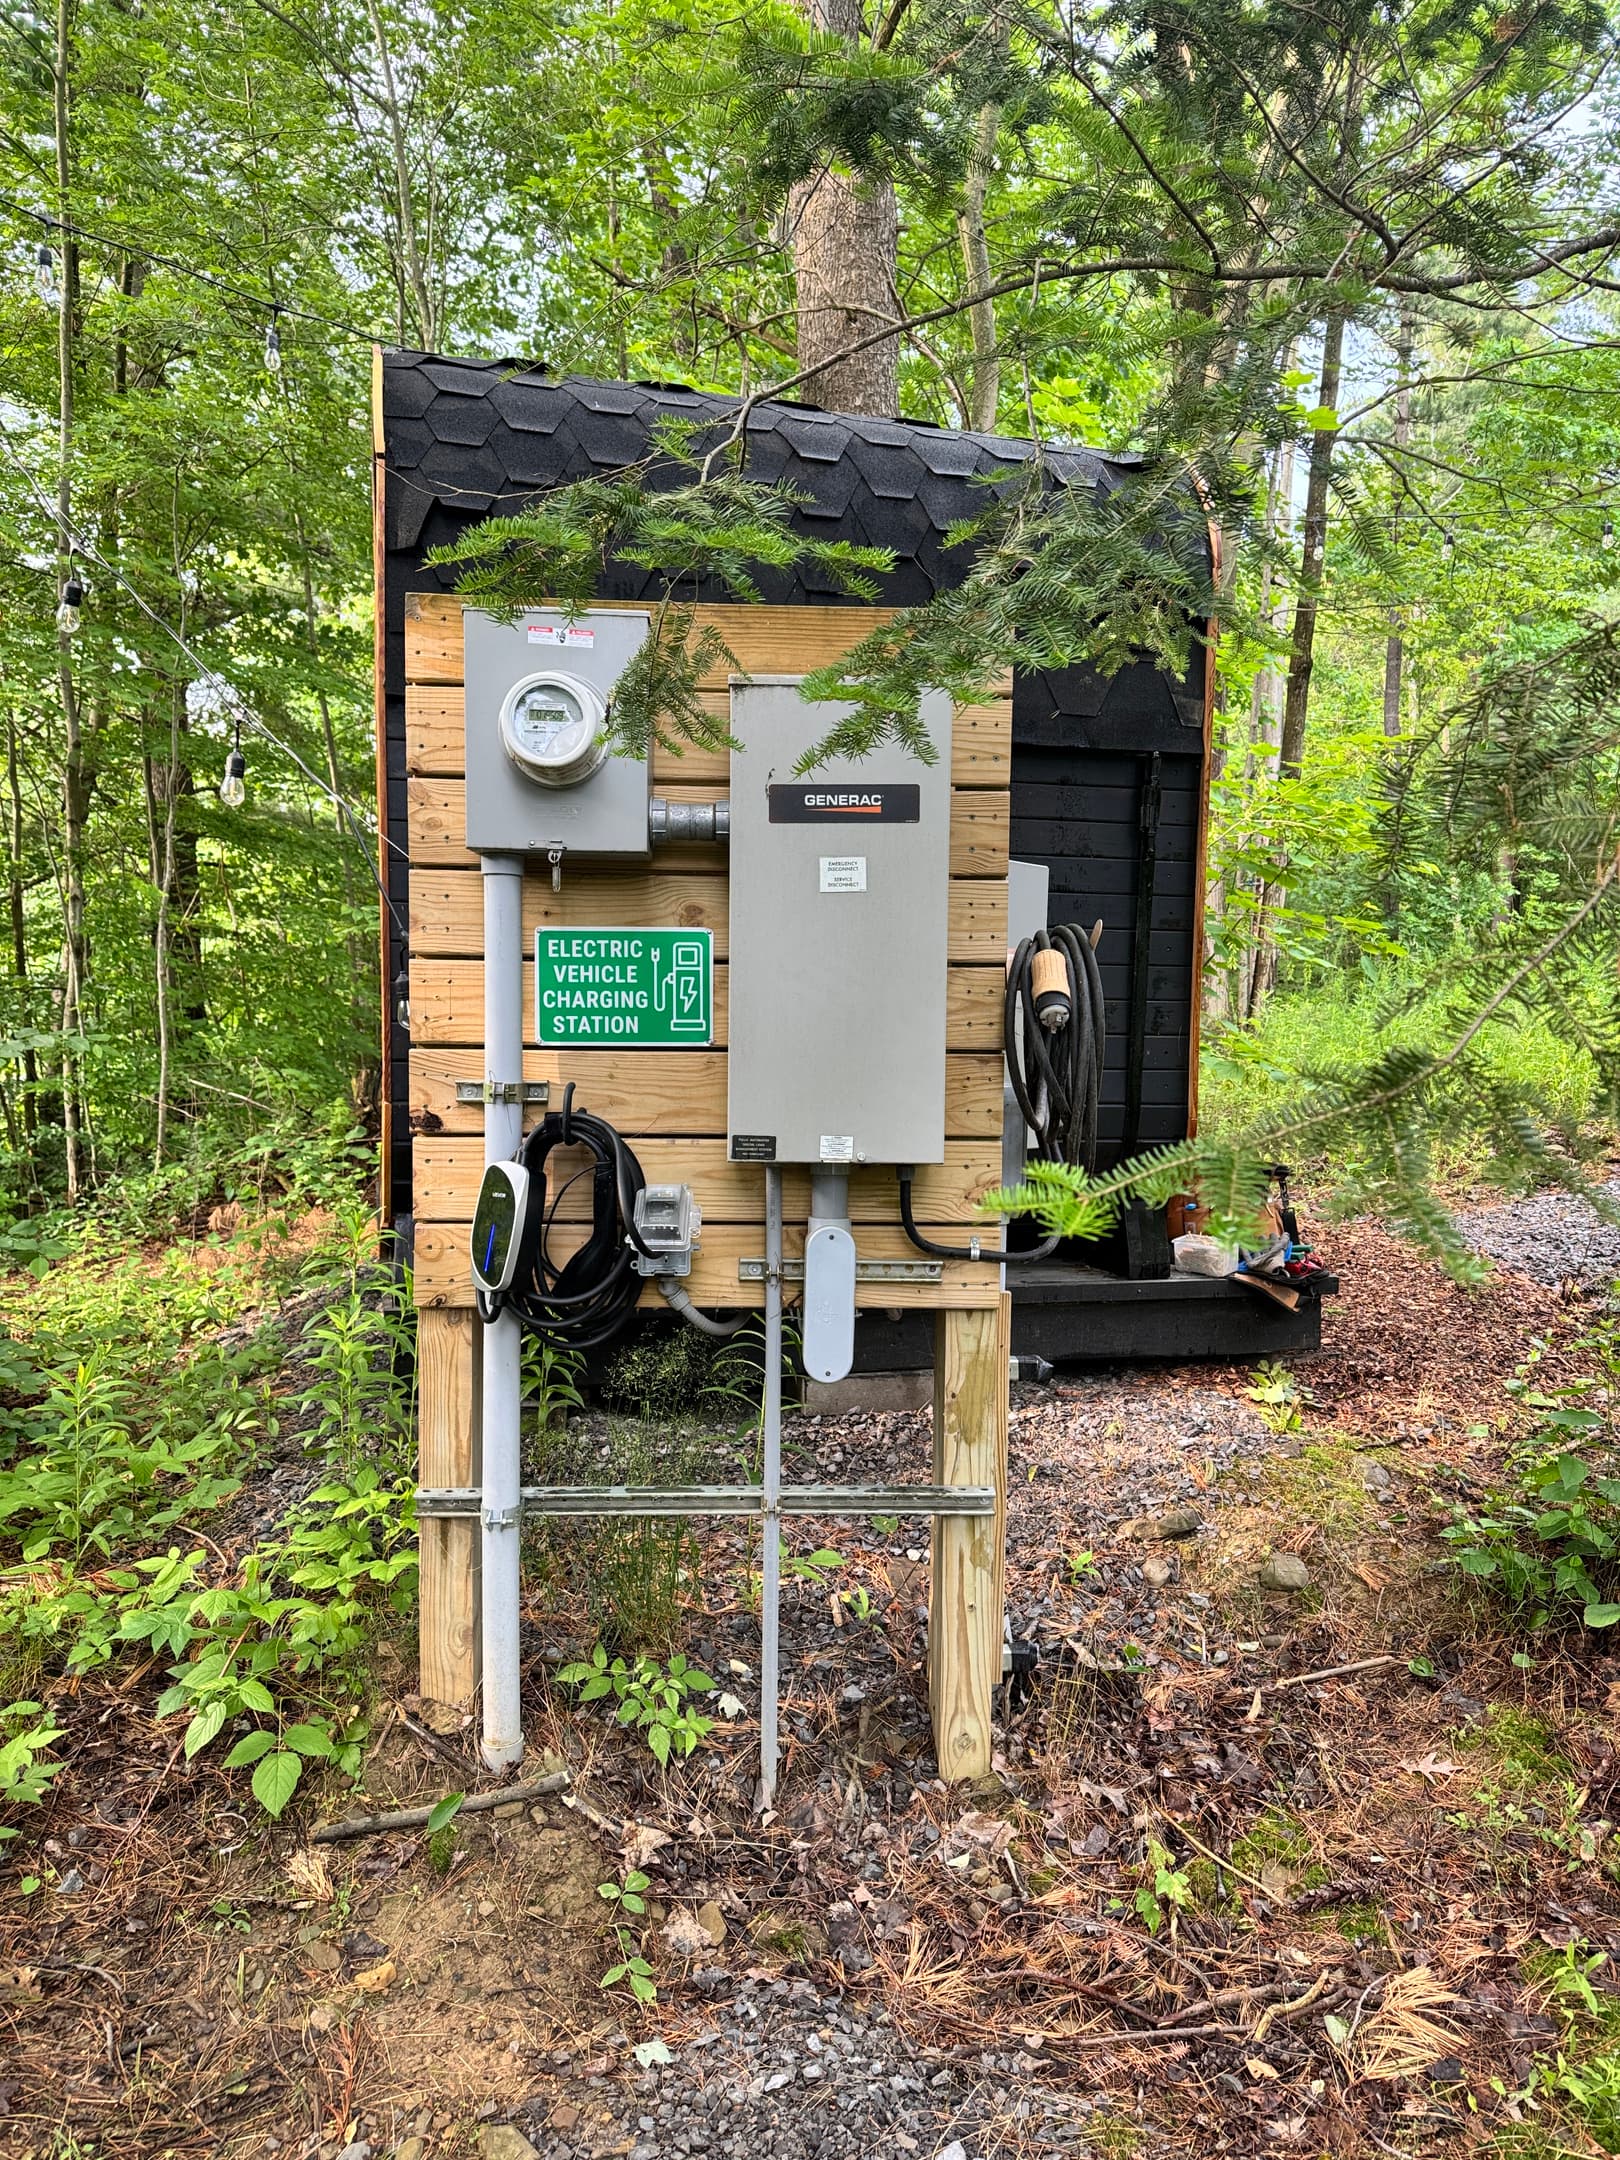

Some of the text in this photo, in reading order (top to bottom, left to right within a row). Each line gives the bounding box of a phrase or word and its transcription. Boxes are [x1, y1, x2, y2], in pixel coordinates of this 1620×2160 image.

[804, 794, 882, 806] GENERAC
[547, 939, 643, 958] ELECTRIC
[553, 965, 638, 984] VEHICLE
[542, 990, 648, 1009] CHARGING
[552, 1015, 639, 1034] STATION
